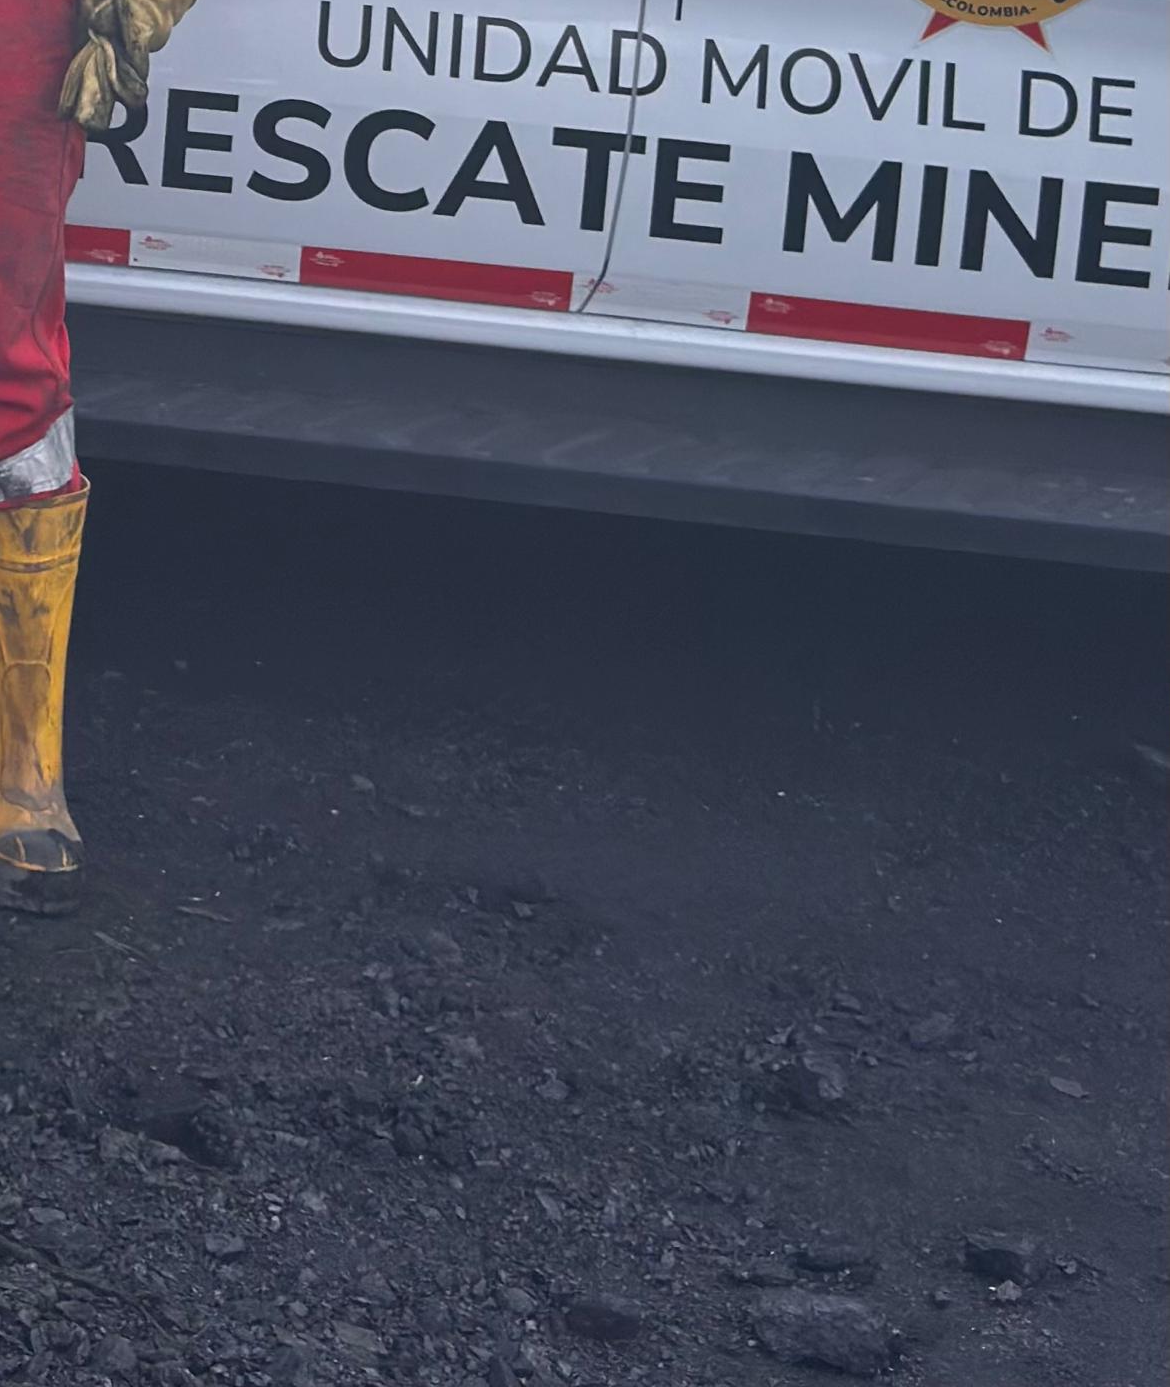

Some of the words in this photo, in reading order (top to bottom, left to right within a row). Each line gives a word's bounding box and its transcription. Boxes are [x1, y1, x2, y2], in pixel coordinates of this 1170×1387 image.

[317, 0, 668, 97] UNIDAD
[701, 37, 986, 132] MOVIL
[1018, 68, 1136, 146] DE
[78, 87, 731, 245] RESCATE
[782, 150, 1170, 290] MINE
